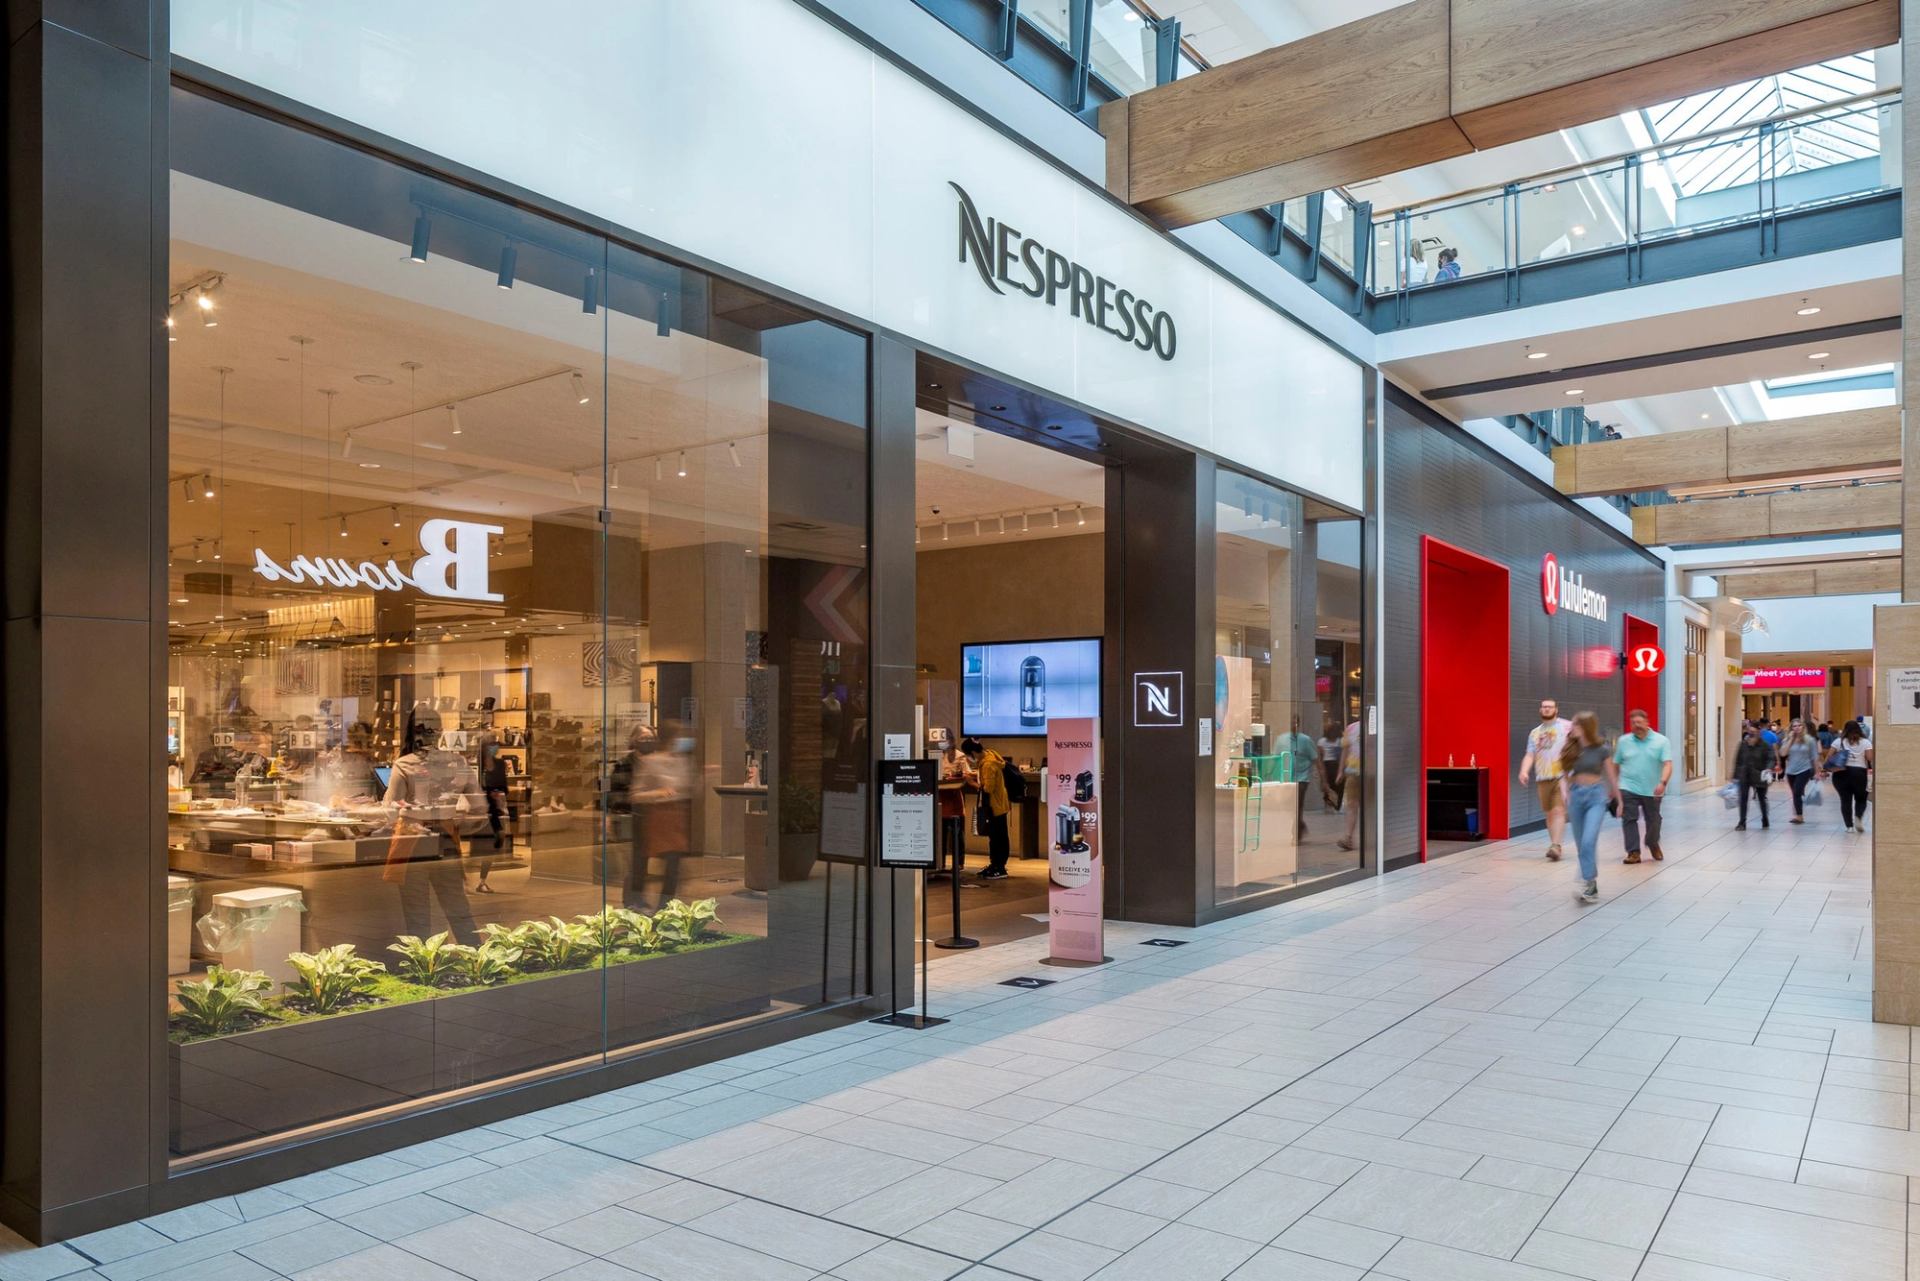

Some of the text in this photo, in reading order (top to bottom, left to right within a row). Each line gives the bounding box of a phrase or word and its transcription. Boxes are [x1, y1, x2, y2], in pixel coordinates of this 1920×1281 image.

[948, 181, 1177, 362] NESPRESSO
[1559, 566, 1607, 622] lululemon
[1779, 670, 1797, 679] you
[1798, 668, 1822, 676] there
[1055, 741, 1093, 749] NESPRESSO
